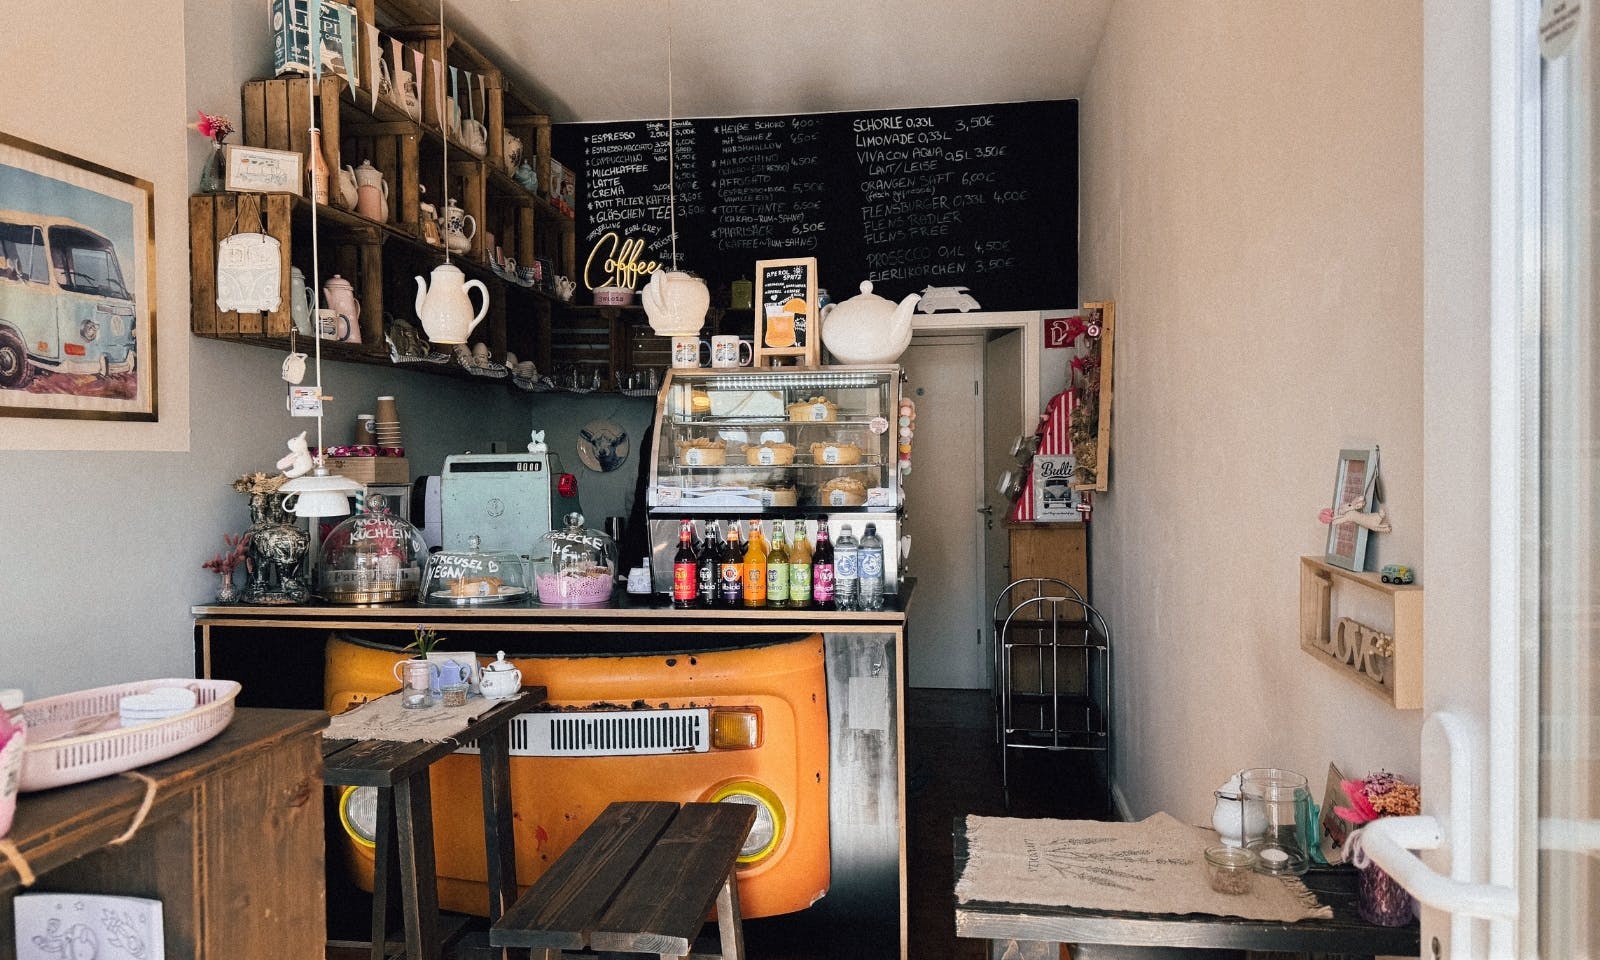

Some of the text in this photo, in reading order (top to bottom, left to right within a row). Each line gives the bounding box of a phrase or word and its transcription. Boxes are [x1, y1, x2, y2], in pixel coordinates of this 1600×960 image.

[853, 116, 903, 132] SCHORLE
[954, 114, 995, 132] 3,50€
[591, 131, 636, 144] ESPRESSO
[855, 132, 915, 147] LIMONADE
[592, 164, 649, 178] MILCHKAFFEE
[592, 177, 621, 189] LATTE
[591, 185, 625, 199] CREMA
[615, 196, 645, 208] FILTER
[596, 207, 646, 223] GLÄSCHEN
[647, 205, 671, 220] TEE
[791, 221, 827, 235] 6,50€
[584, 232, 663, 290] Coffee
[1041, 461, 1074, 478] Bulli
[429, 554, 483, 571] STREUSEL
[428, 565, 466, 580] VEGAN
